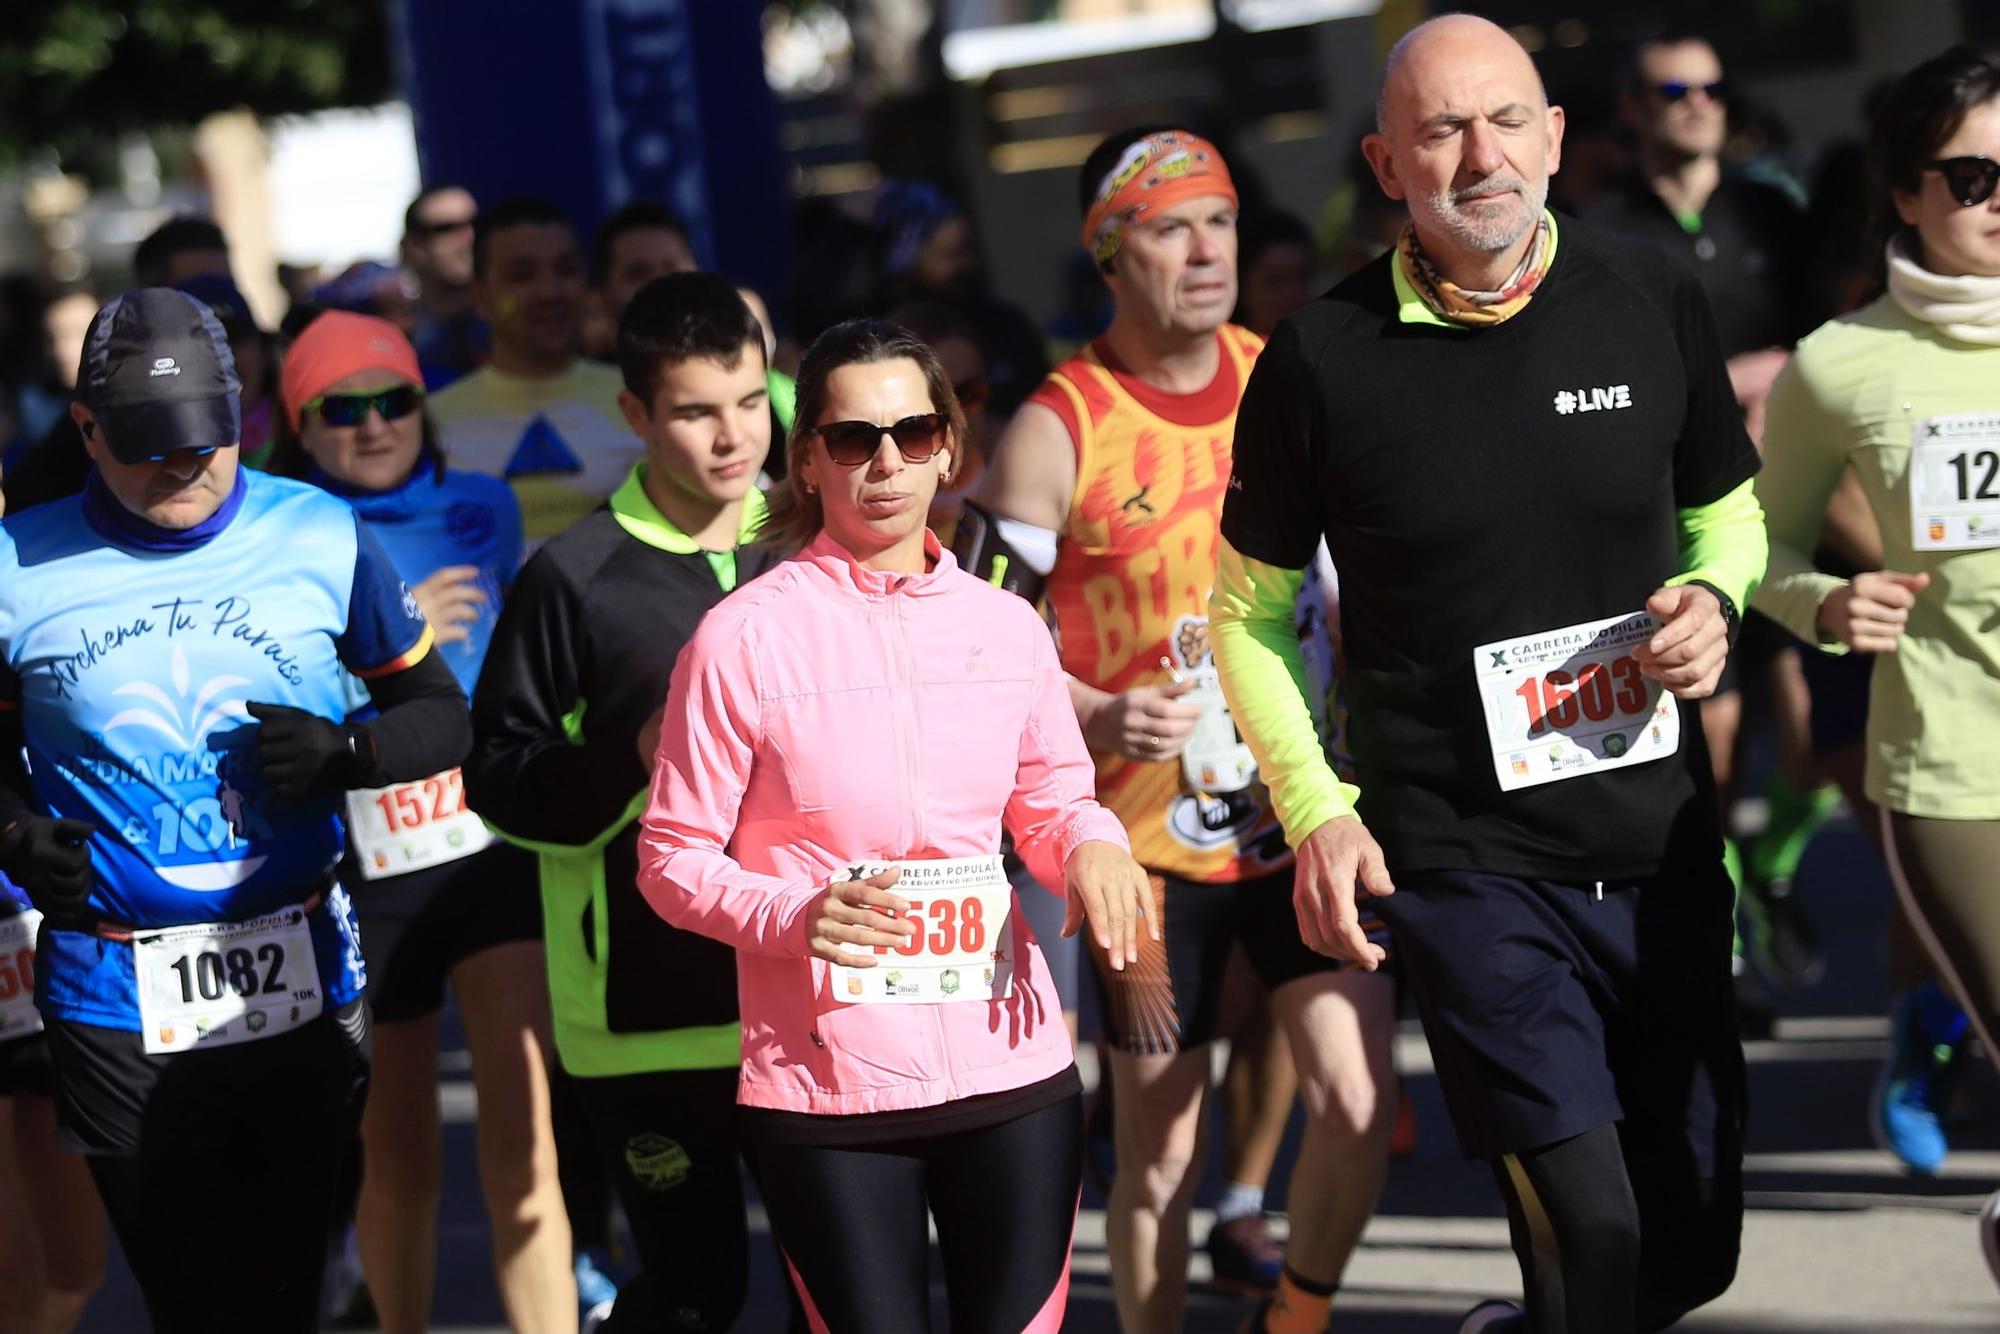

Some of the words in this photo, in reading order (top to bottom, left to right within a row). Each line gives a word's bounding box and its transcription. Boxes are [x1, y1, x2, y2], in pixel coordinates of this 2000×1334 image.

[1553, 384, 1632, 415] #LIVE
[48, 617, 154, 701] Archena
[152, 597, 204, 638] Tu
[213, 596, 303, 687] Paraiso
[1511, 633, 1584, 657] CARRERA
[1589, 616, 1653, 640] POPULAR
[1515, 655, 1649, 735] 1603
[870, 867, 942, 878] CRERA
[171, 943, 288, 1003] 1082
[292, 989, 316, 1001] 10K
